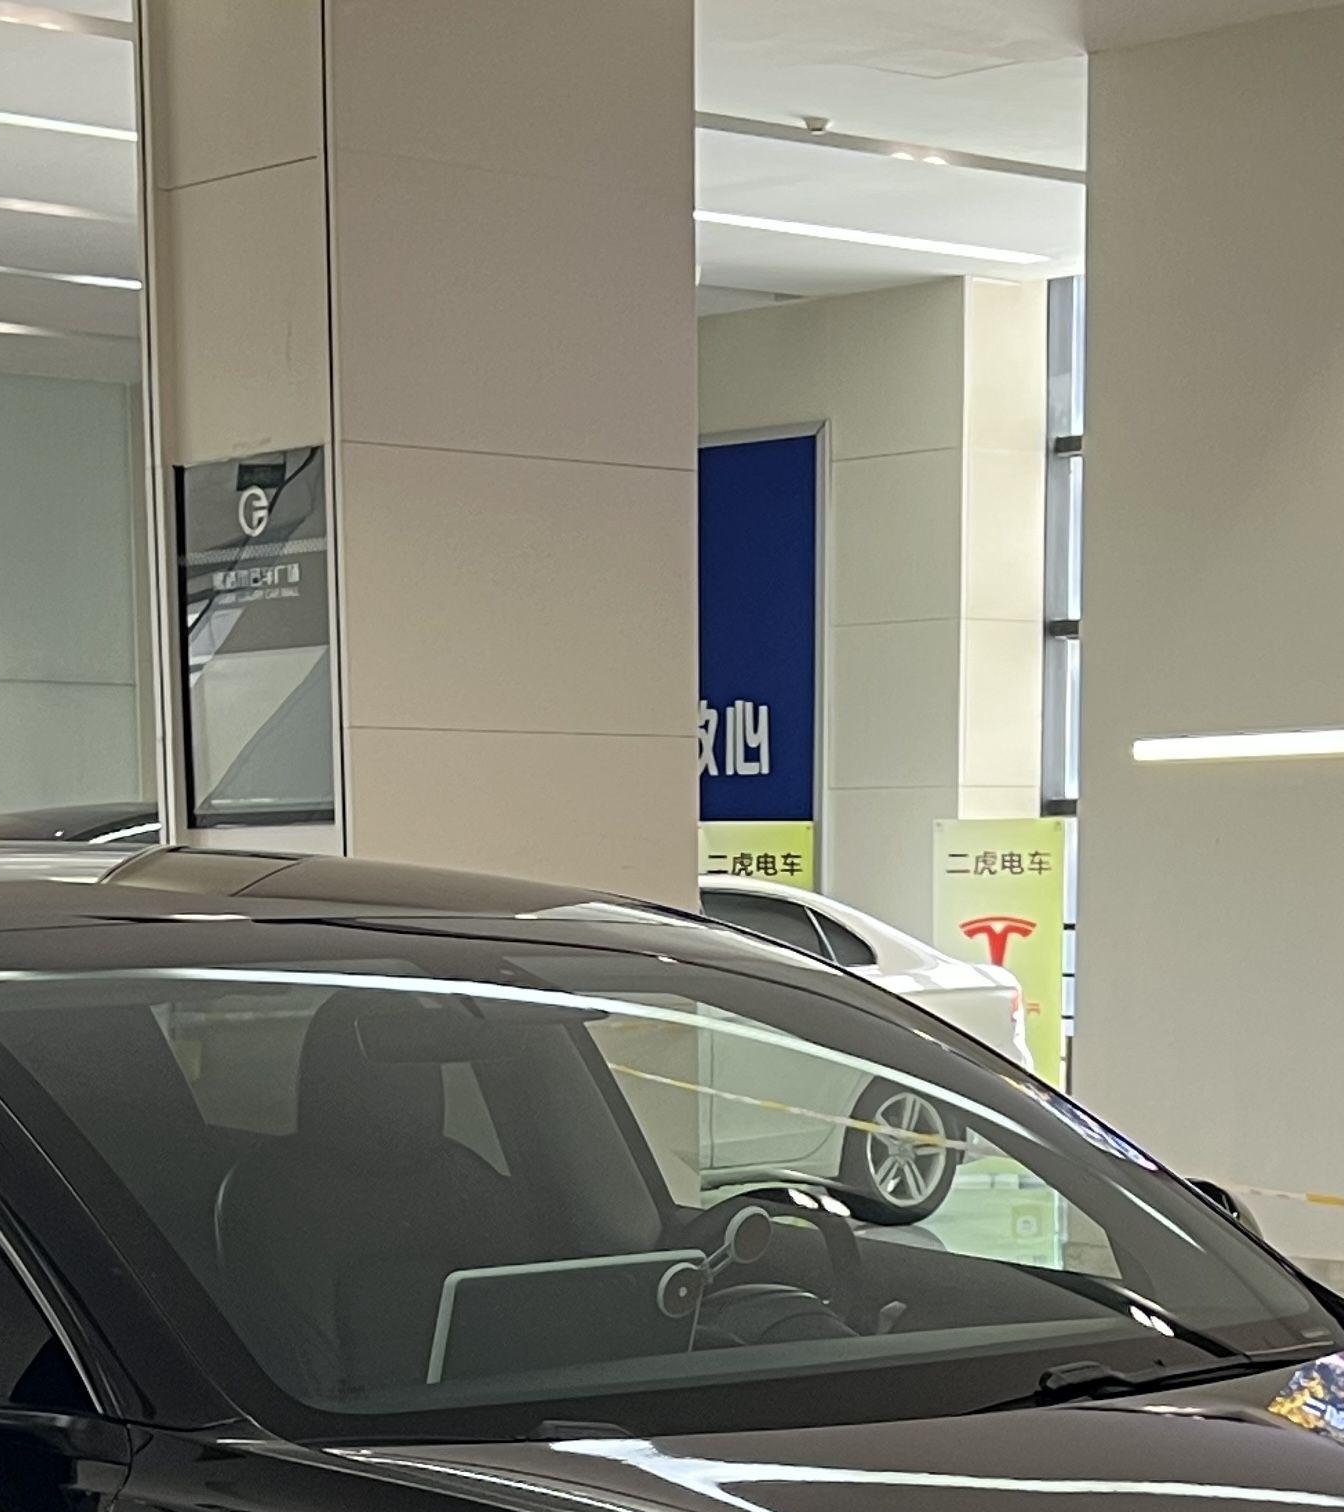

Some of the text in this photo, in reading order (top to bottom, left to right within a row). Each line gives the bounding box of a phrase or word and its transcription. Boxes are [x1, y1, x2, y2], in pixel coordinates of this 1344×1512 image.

[707, 853, 803, 877] 二虎电车
[945, 850, 1052, 875] 二虎电车
